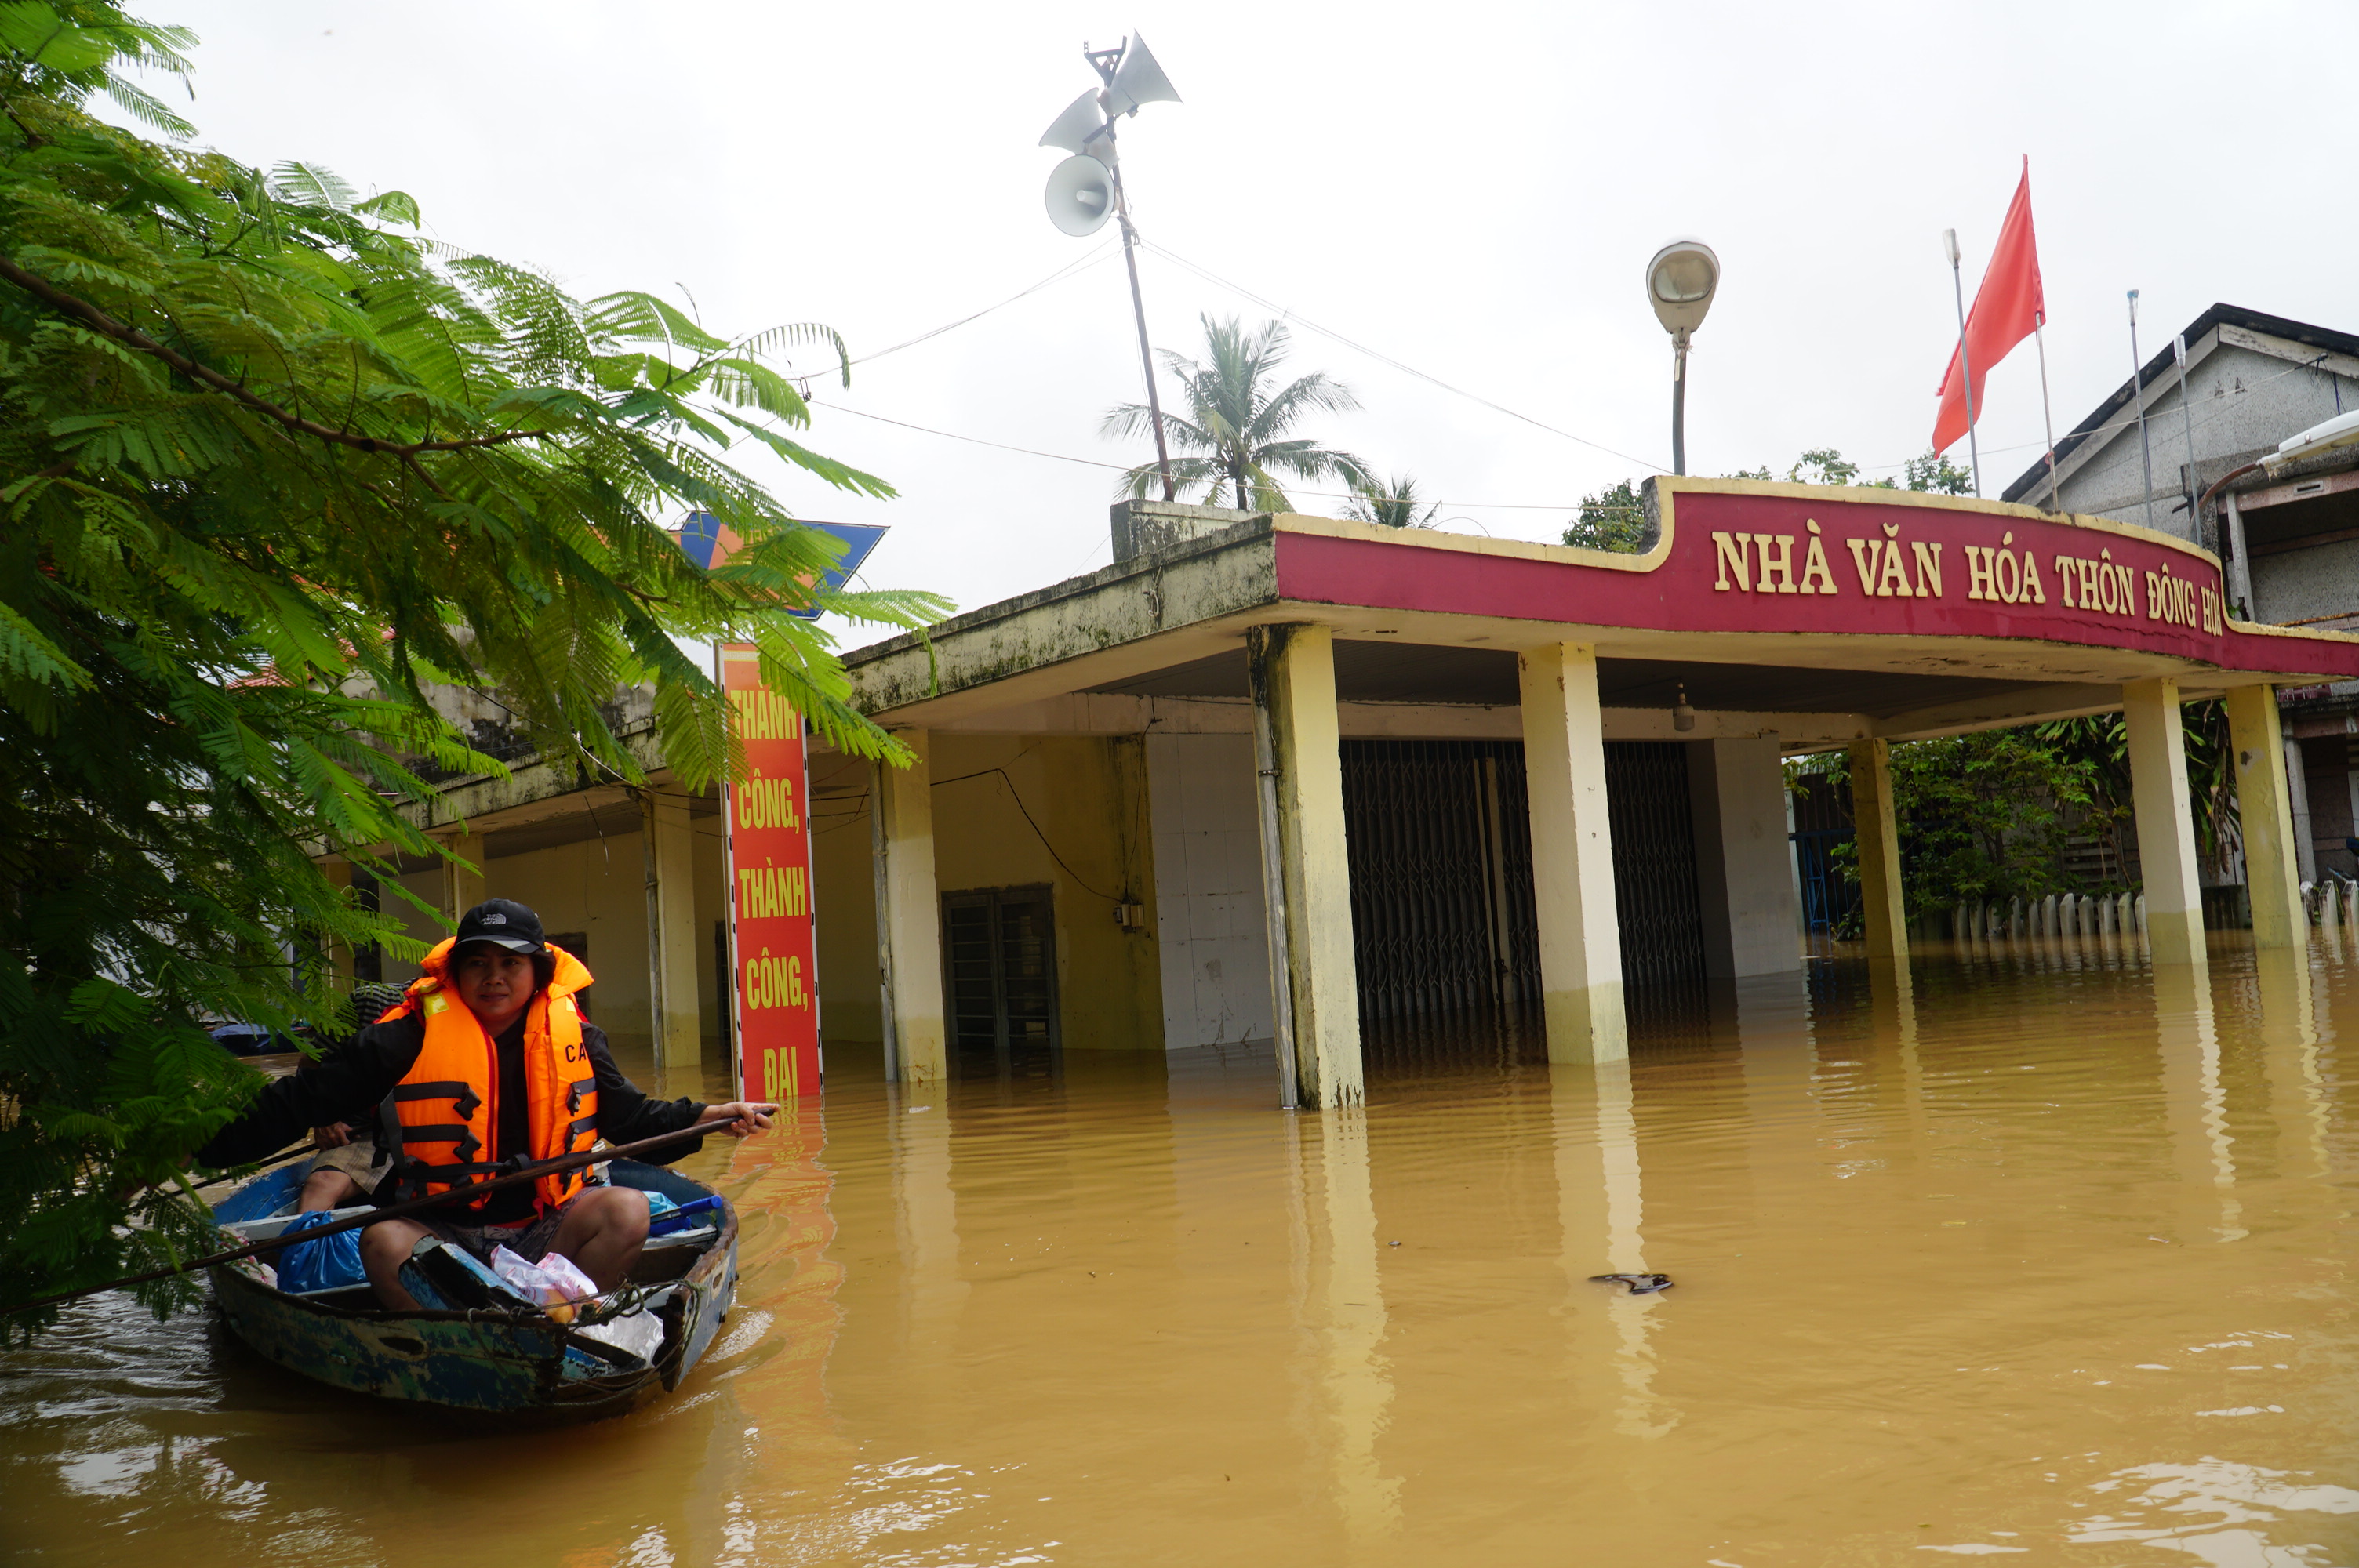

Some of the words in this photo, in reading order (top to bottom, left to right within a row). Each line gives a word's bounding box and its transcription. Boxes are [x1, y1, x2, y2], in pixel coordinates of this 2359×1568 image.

[1711, 518, 1838, 594] NHÀ
[1846, 522, 1943, 597] VĂN
[1965, 531, 2046, 604] HÓA
[2055, 547, 2135, 615] THÔN
[2146, 561, 2196, 629] ĐÔNG
[2201, 579, 2223, 637] HÒA
[730, 679, 798, 739] THÀNH
[738, 768, 799, 834] CÔNG,
[739, 857, 806, 919] THÀNH
[747, 947, 808, 1011] CÔNG,
